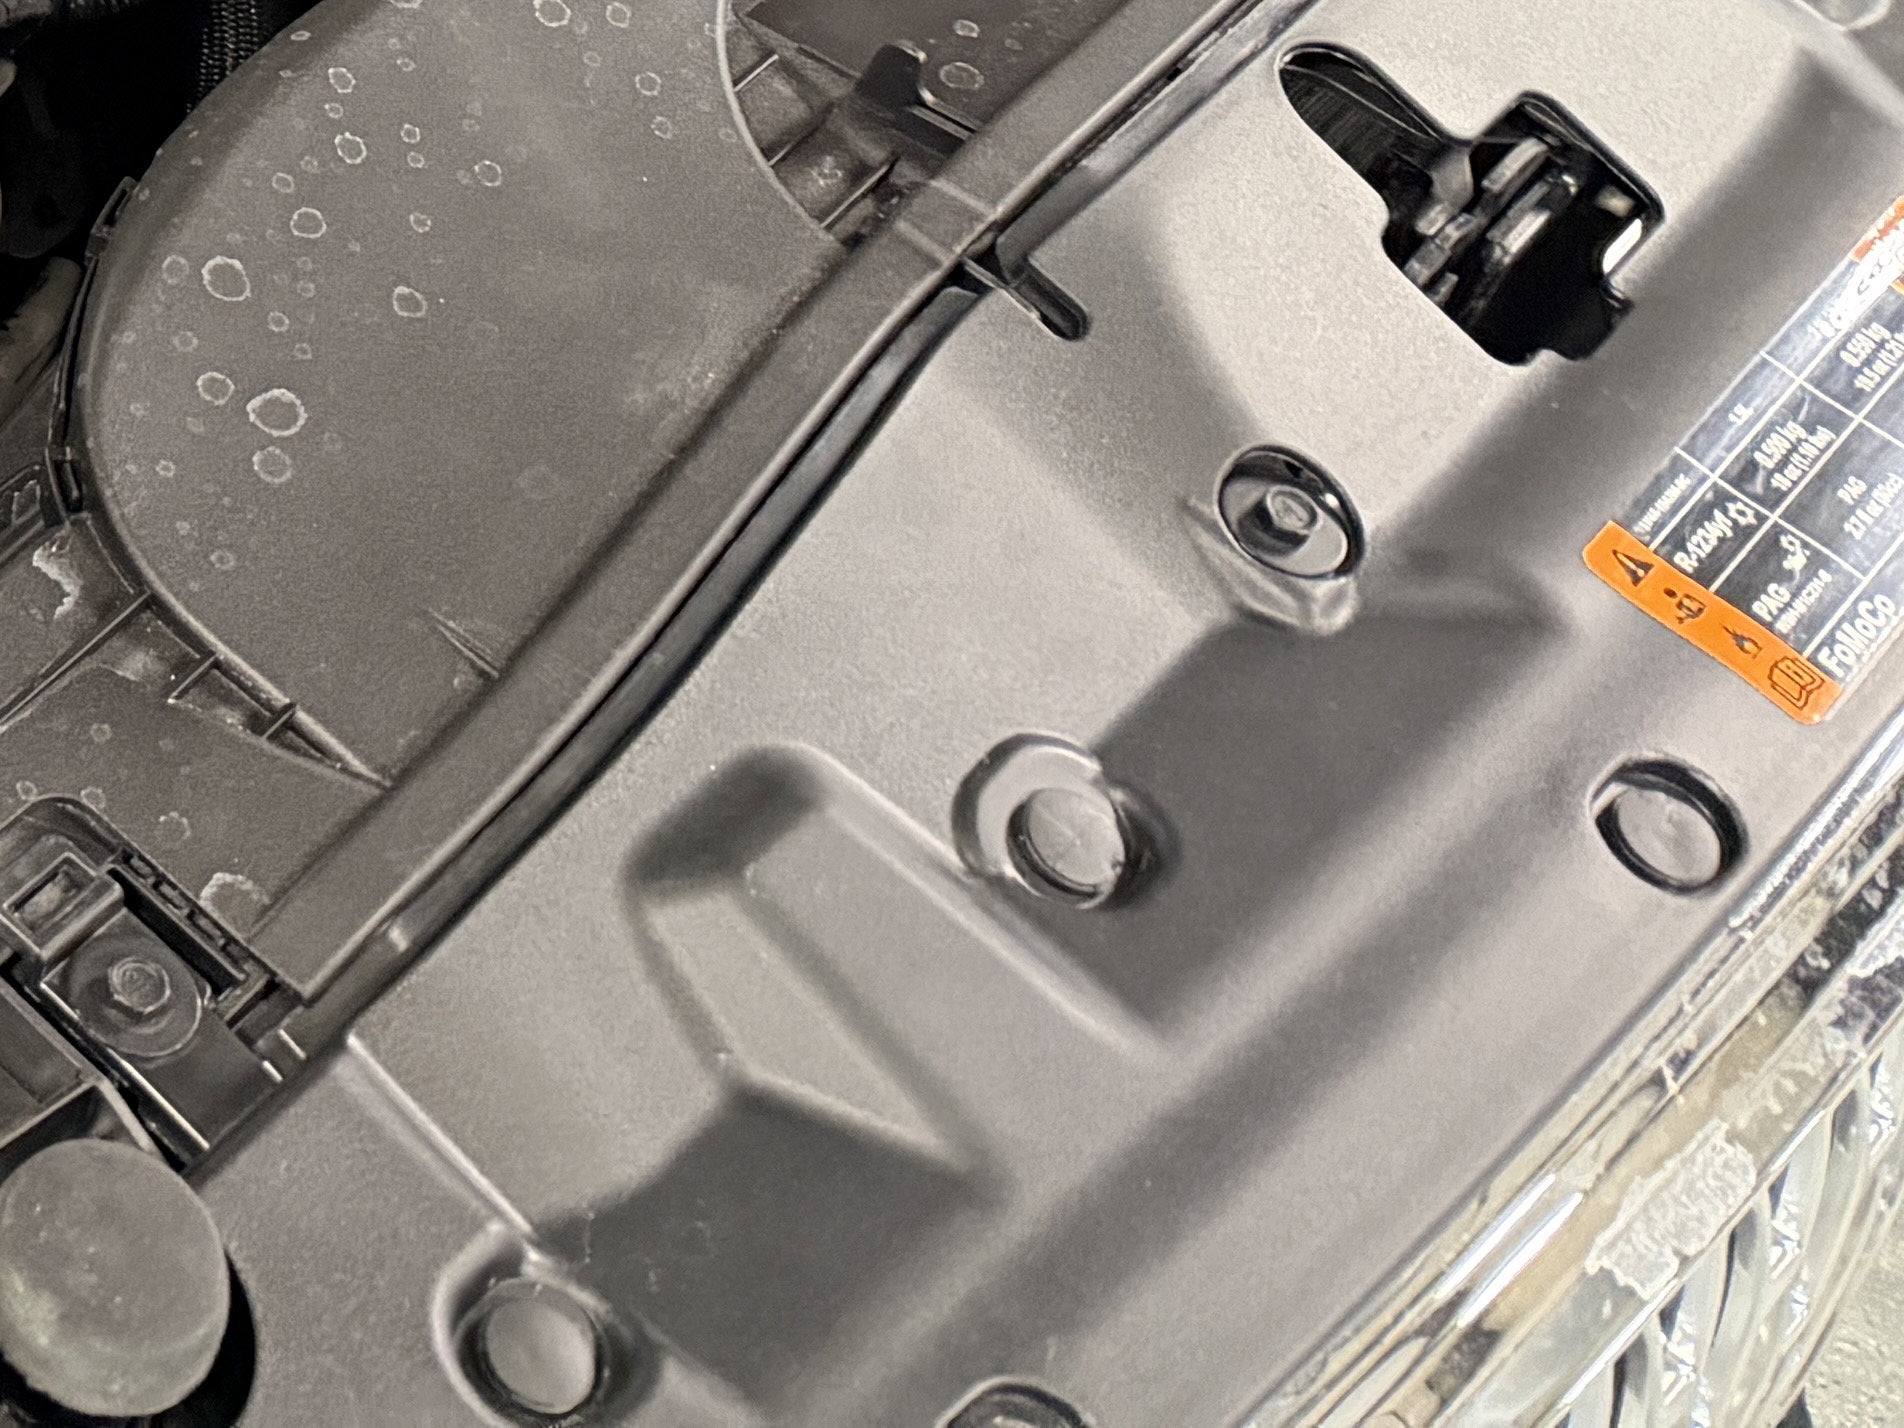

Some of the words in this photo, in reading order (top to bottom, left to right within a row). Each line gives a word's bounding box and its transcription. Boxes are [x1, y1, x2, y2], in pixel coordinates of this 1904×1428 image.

[1776, 416, 1808, 446] kg
[1837, 475, 1869, 507] PAG
[1673, 510, 1735, 575] R-1234yf
[1752, 581, 1792, 623] PAG
[1817, 593, 1900, 678] FoMoCo
